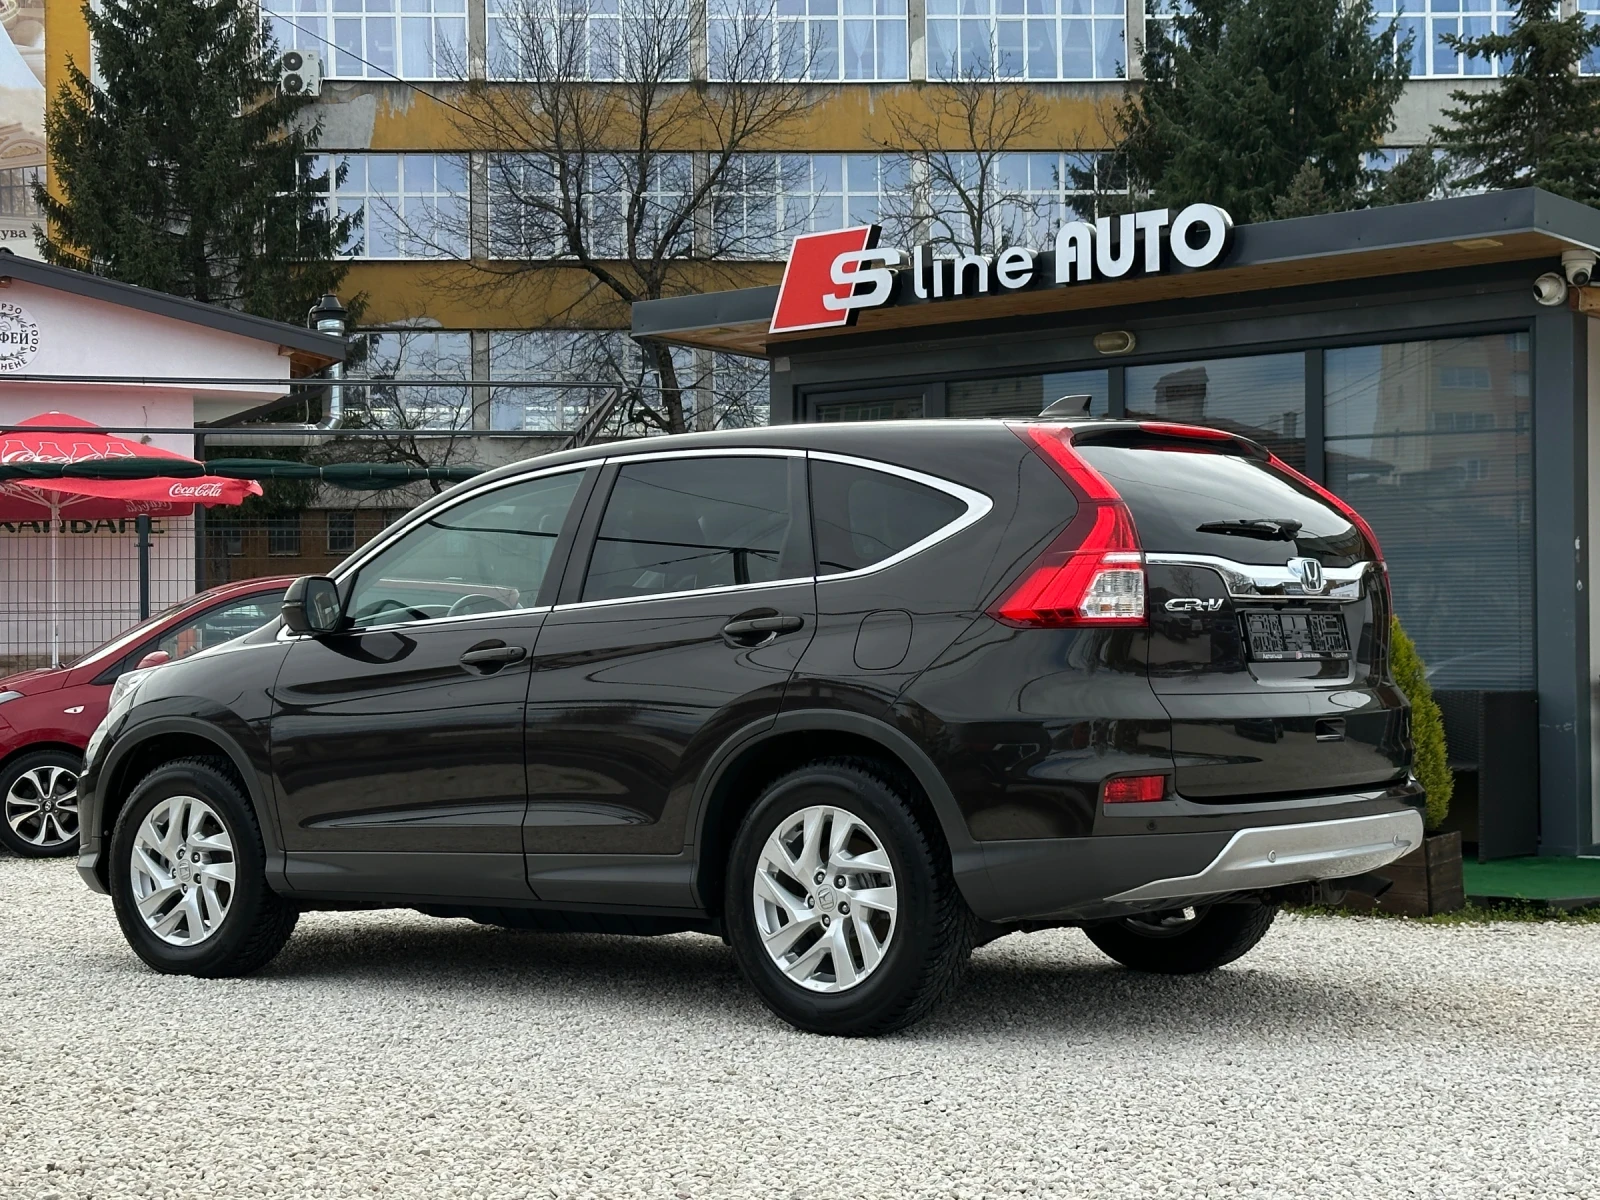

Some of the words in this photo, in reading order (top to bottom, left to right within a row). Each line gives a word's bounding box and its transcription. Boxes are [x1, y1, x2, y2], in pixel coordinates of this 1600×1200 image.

[914, 246, 1034, 299] line
[1056, 203, 1226, 284] AUTO
[29, 323, 39, 352] FOOD
[169, 482, 224, 497] Coca-Cola
[1164, 597, 1224, 611] CR-V
